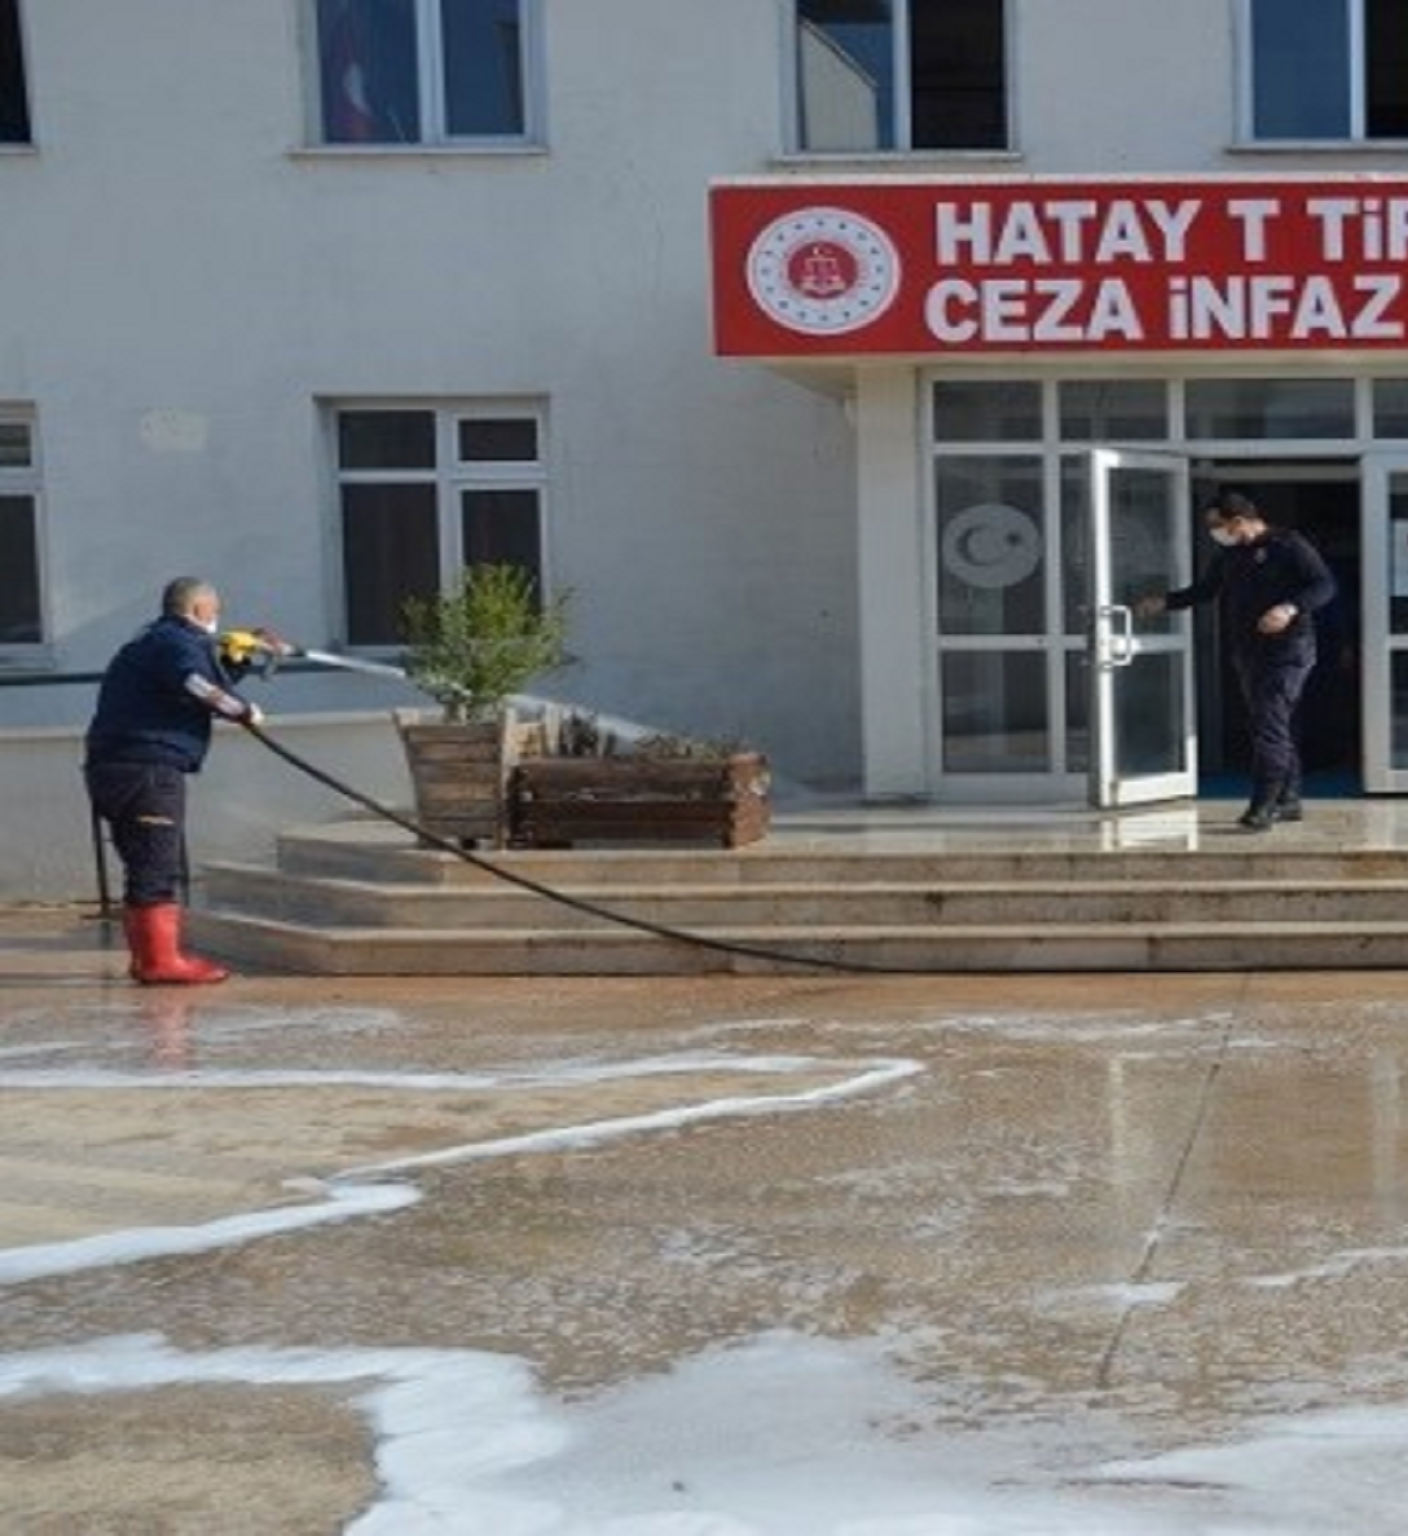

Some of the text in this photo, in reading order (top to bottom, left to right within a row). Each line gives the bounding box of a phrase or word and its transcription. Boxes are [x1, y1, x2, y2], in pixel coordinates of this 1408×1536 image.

[936, 199, 1201, 264] HATAY
[1228, 198, 1279, 260] T
[925, 278, 1143, 342] CEZA
